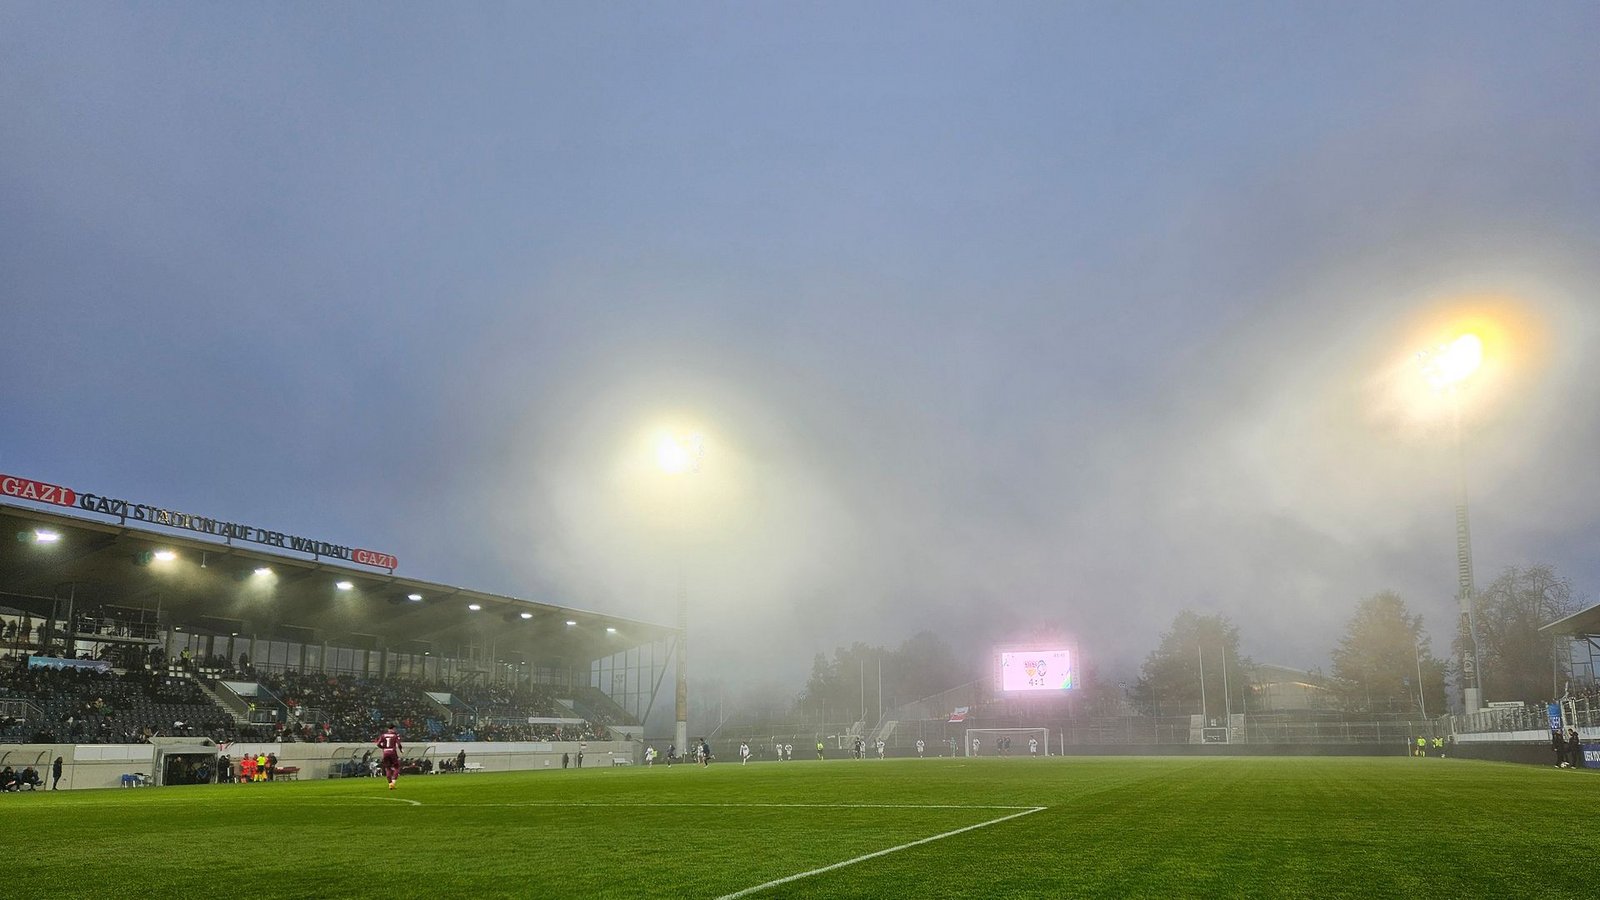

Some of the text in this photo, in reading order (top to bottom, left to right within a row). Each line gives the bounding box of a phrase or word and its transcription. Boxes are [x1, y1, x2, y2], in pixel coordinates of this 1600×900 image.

[2, 477, 69, 506] GAZI
[80, 493, 349, 560] GAZI STADION AUF DER WALDAU
[357, 550, 394, 569] GAZI
[1028, 678, 1045, 687] 4:1
